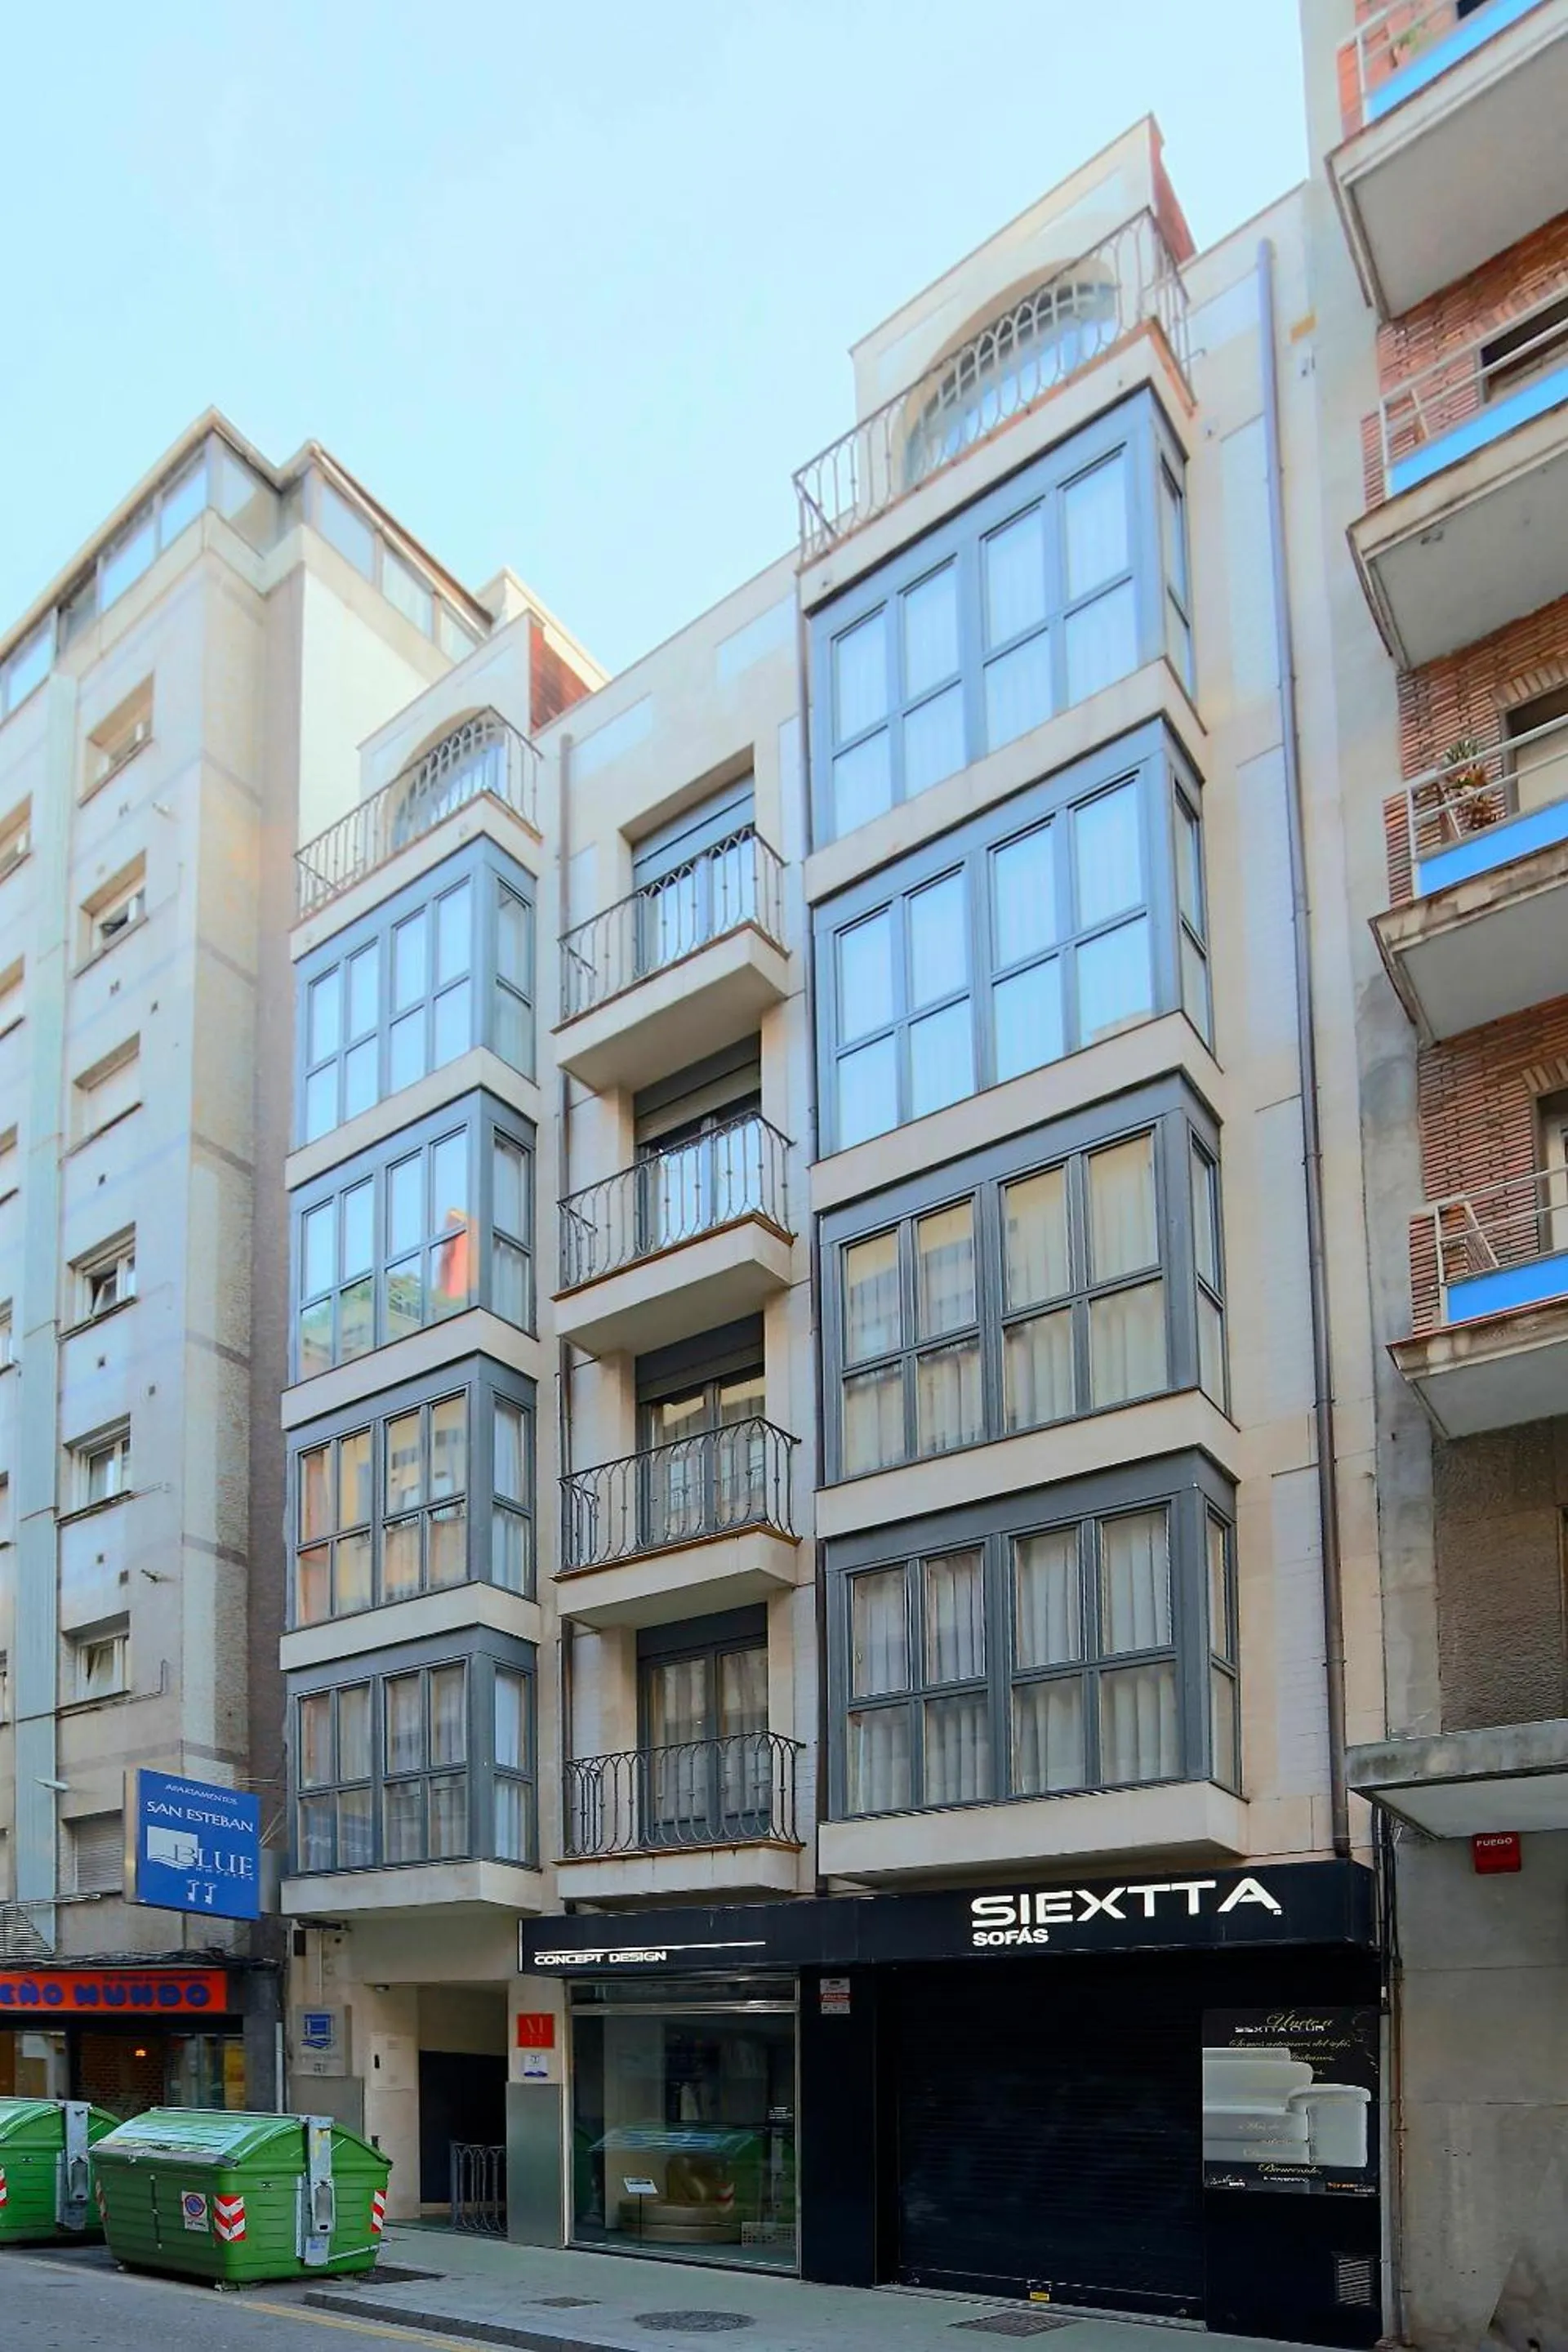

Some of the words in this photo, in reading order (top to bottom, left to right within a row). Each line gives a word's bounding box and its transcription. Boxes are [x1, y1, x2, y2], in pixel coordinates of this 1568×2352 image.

[165, 1784, 238, 1805] APARTAMENTOS
[146, 1801, 182, 1819] SAN
[186, 1809, 253, 1833] ESTEBAN
[174, 1844, 254, 1877] BLUE
[970, 1878, 1282, 1928] SIEXTTA
[972, 1927, 1049, 1947] SOFÁS
[534, 1953, 604, 1966] CONCEPT
[608, 1950, 667, 1963] DESIGN
[74, 1983, 212, 2007] MUNDO
